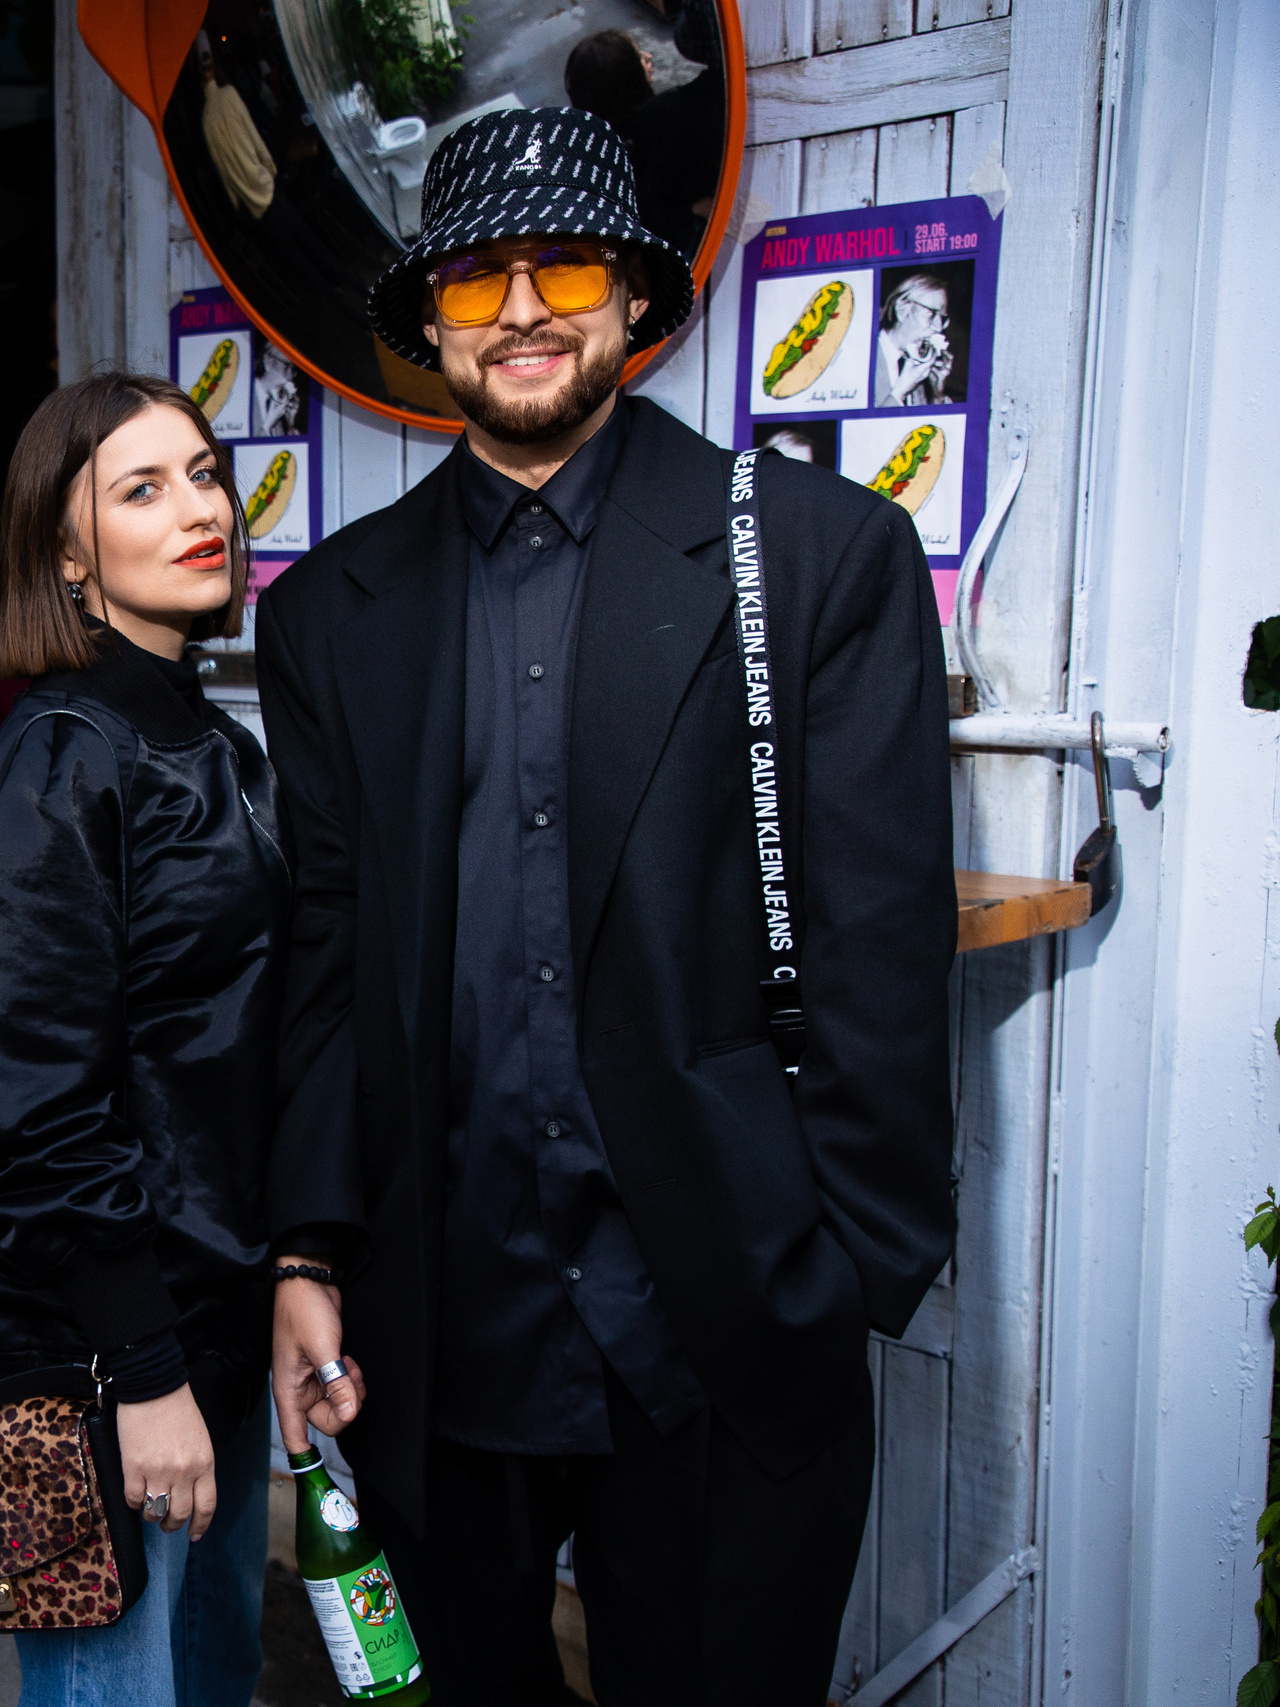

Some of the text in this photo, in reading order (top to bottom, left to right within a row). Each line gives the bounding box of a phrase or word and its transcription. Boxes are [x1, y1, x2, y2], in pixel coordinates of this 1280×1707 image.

[761, 226, 901, 270] ANDY WARHOL
[915, 222, 948, 239] 29.06.
[915, 233, 978, 254] START 19:00
[731, 453, 757, 503] JEANS
[731, 514, 771, 727] CALVIN KLEIN JEANS
[749, 742, 793, 953] CALVIN KLEIN JEANS
[365, 1629, 400, 1655] СИДР
